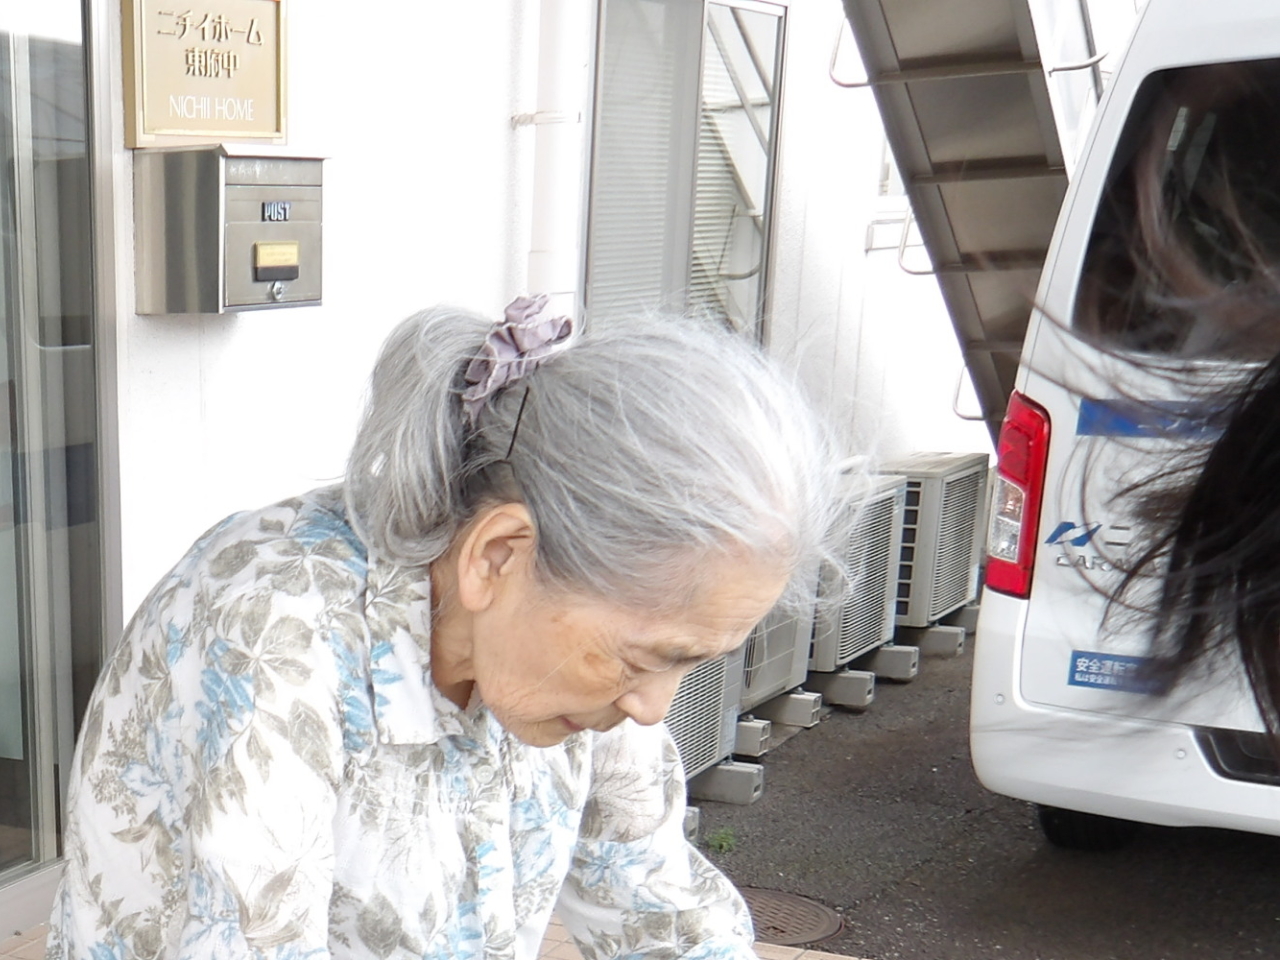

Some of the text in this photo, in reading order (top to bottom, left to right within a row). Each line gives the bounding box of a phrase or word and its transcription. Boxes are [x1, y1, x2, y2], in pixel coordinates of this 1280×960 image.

[157, 10, 264, 46] ニチイホーム
[185, 47, 239, 78] 東府中
[169, 95, 254, 121] NICHII HOME
[261, 201, 292, 222] POST
